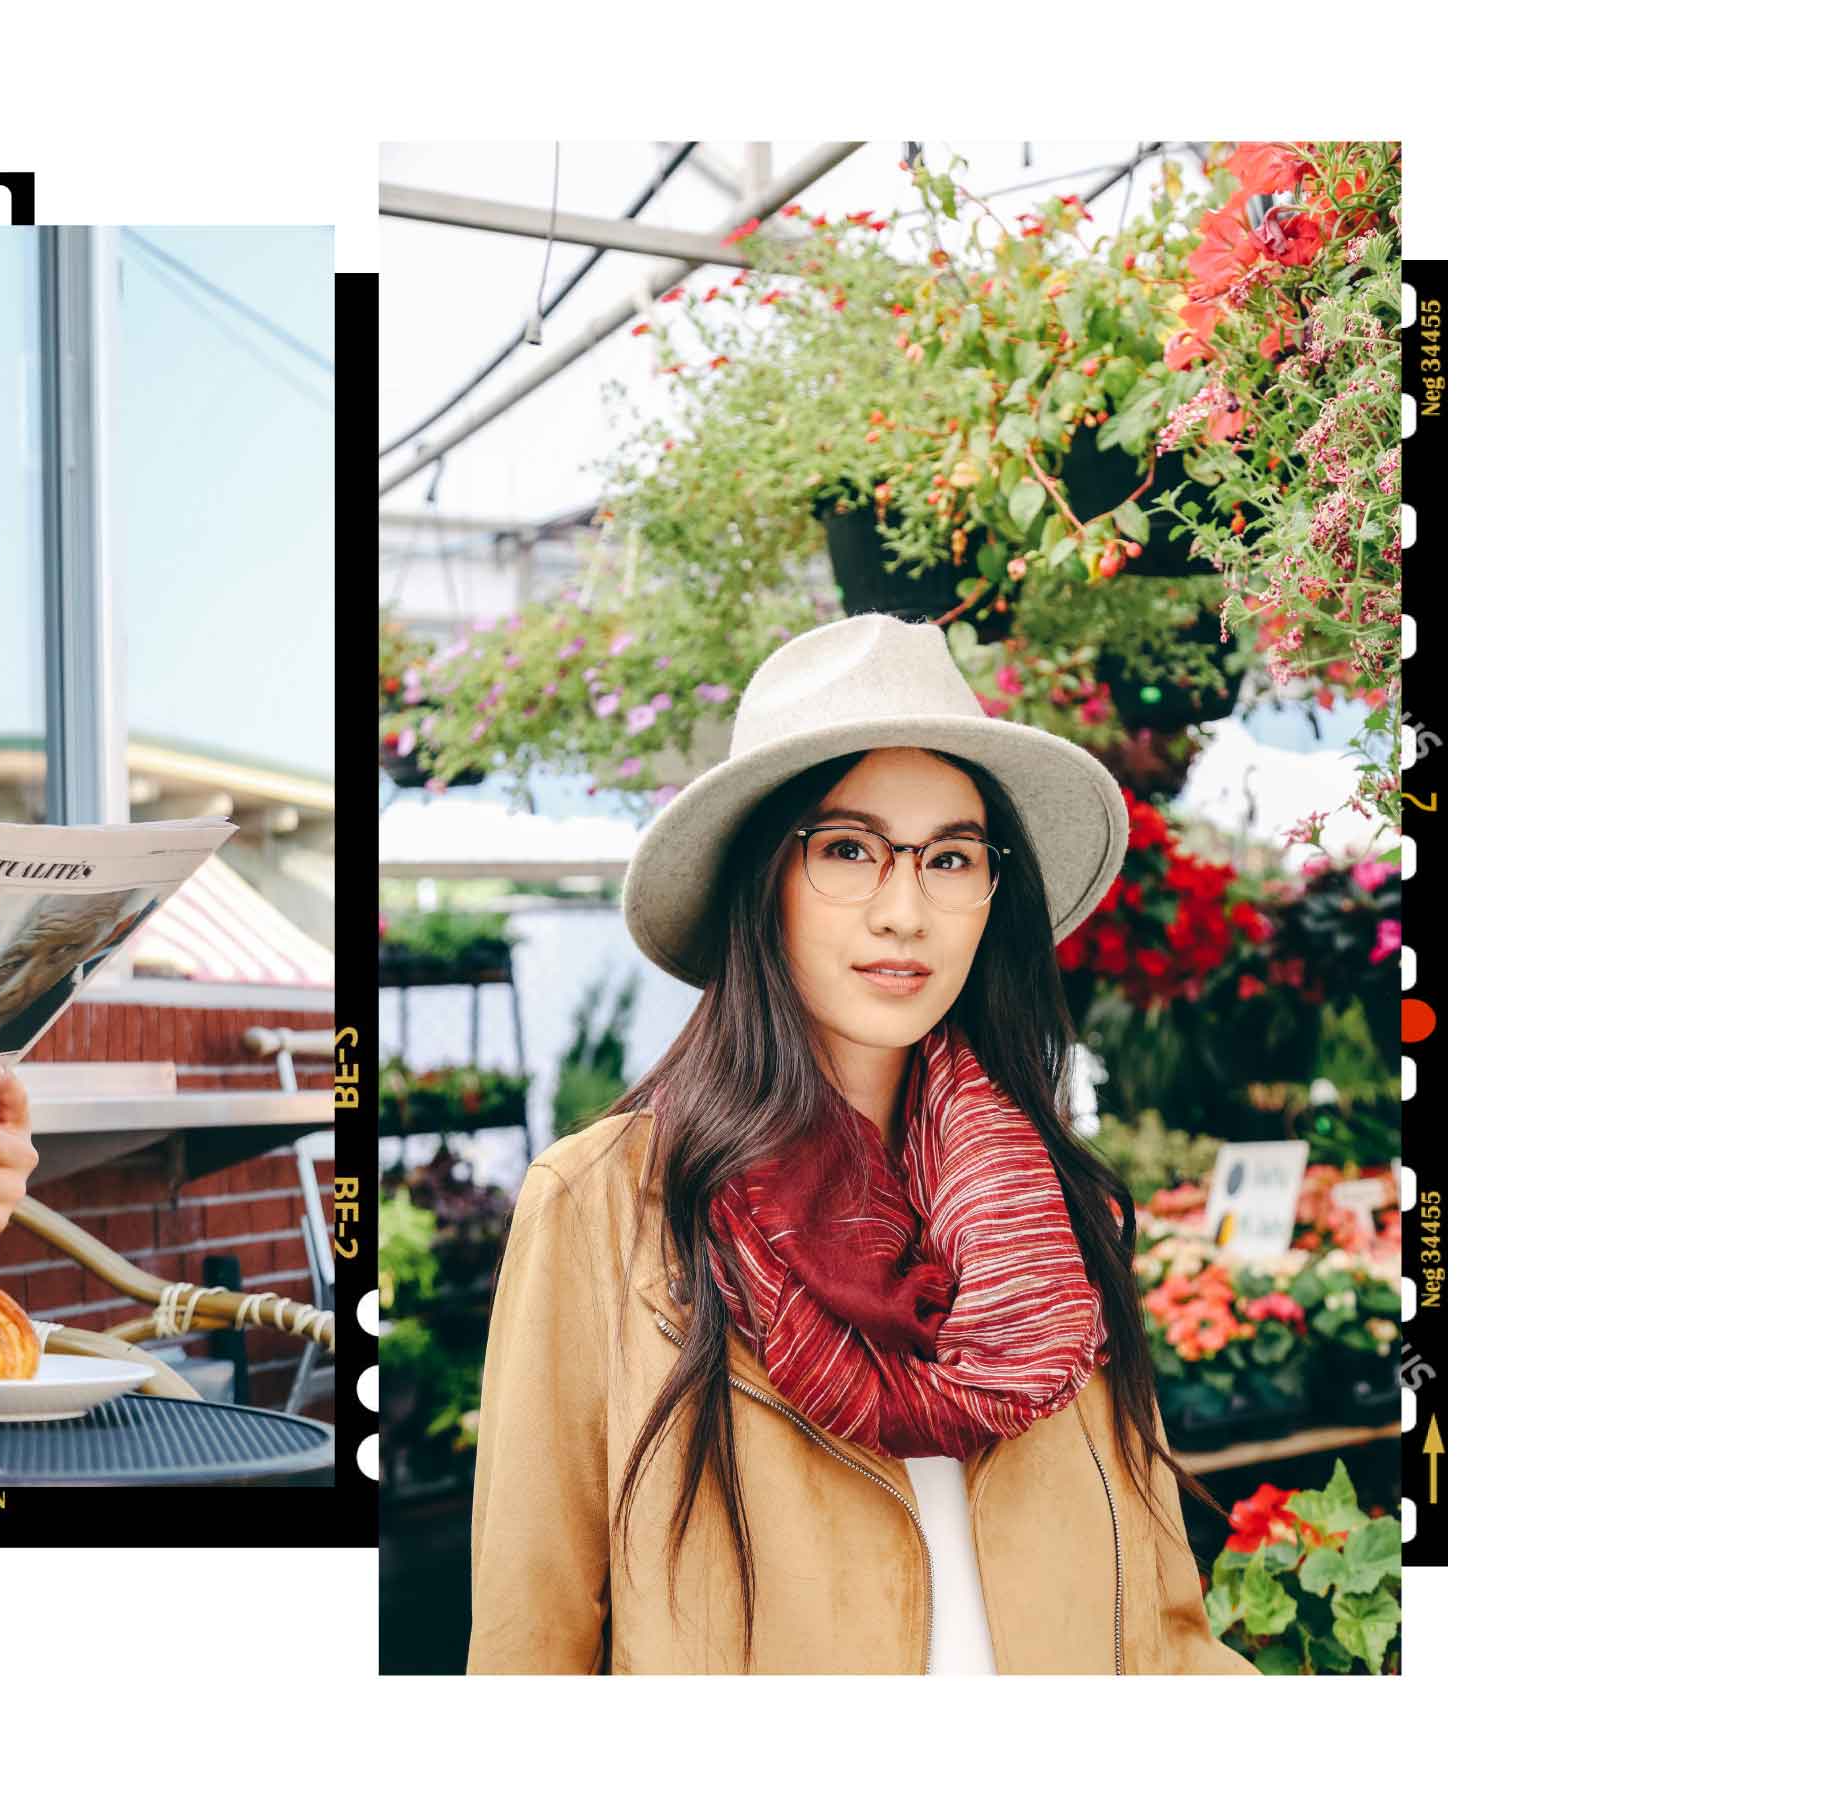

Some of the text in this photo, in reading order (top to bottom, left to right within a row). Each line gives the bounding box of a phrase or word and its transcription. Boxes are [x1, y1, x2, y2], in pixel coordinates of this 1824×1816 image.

[1421, 299, 1445, 416] Neg 34455
[1420, 1189, 1445, 1308] Neg 34455
